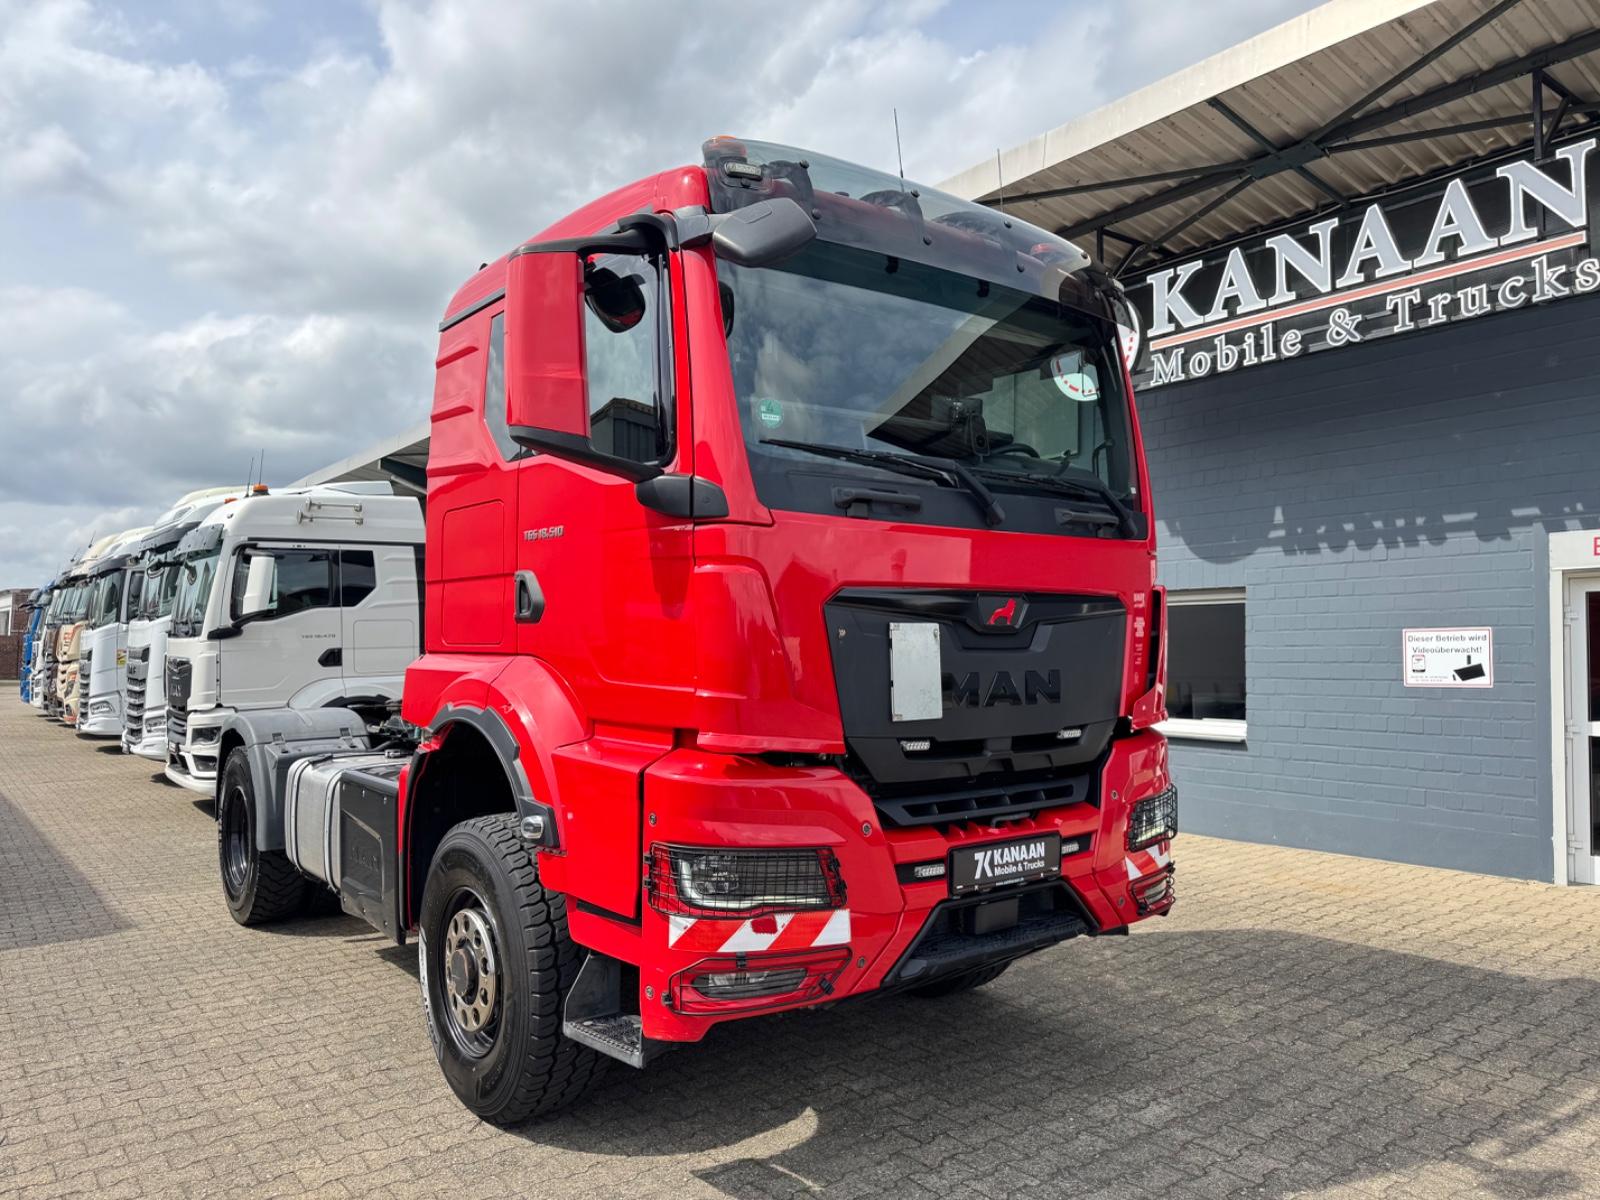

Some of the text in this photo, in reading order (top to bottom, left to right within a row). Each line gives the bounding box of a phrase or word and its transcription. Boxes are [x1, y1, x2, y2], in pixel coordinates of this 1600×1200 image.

[1146, 138, 1597, 338] KANAAN
[1150, 254, 1600, 387] Mobile & Trucks
[1408, 633, 1487, 642] Dieser Betrieb wird
[1412, 646, 1482, 654] Videoüberwacht!
[941, 669, 1061, 708] MAN
[993, 842, 1045, 865] KANAAN
[994, 864, 1017, 877] Mobile
[1017, 862, 1023, 872] &
[1023, 859, 1045, 871] Trucks
